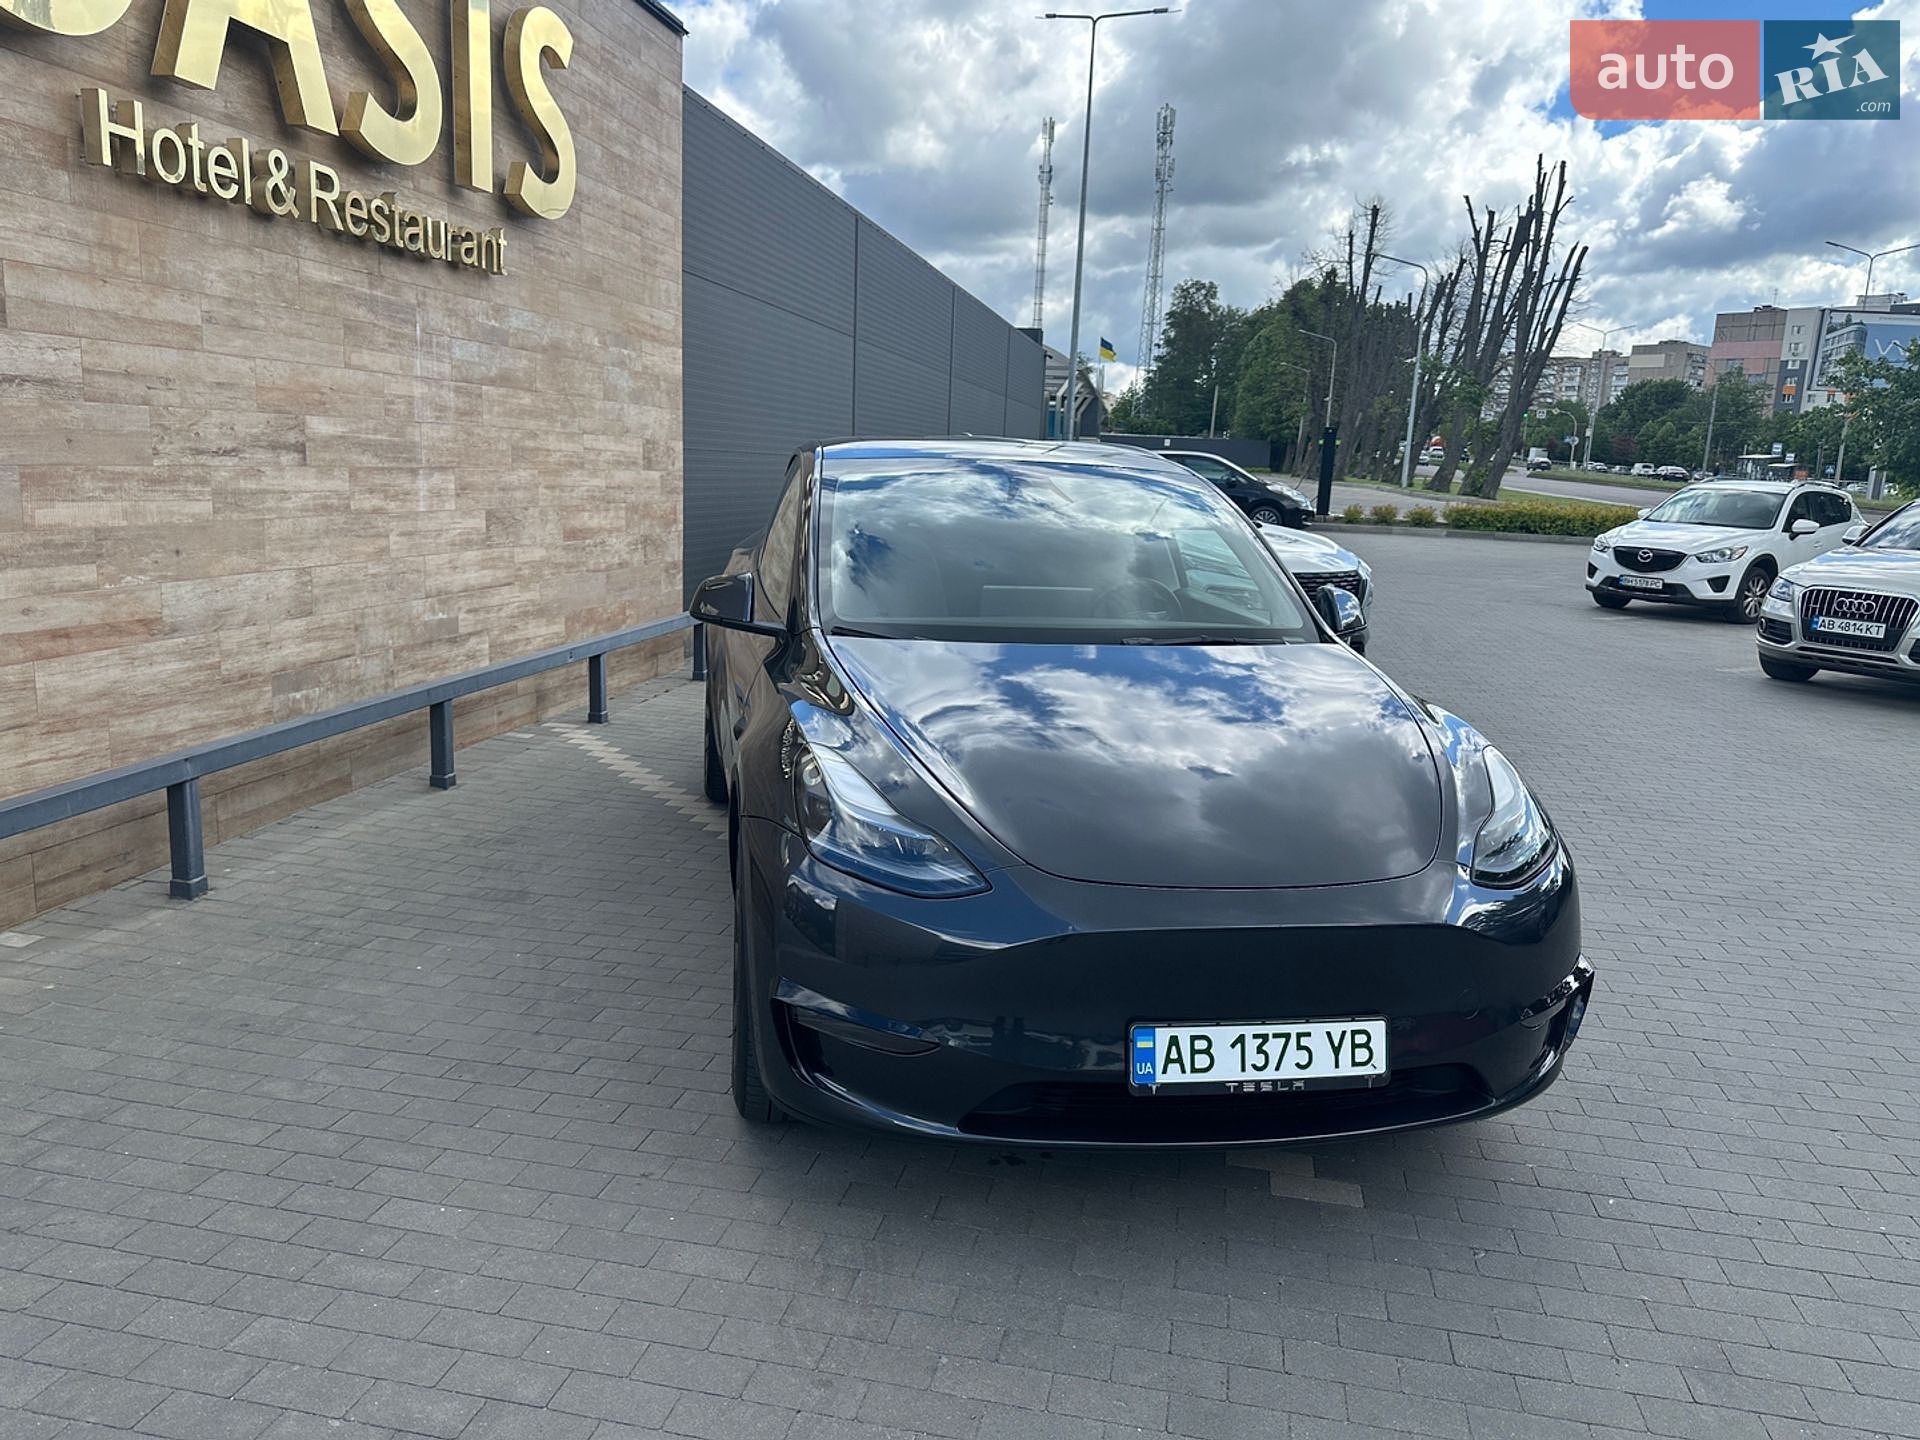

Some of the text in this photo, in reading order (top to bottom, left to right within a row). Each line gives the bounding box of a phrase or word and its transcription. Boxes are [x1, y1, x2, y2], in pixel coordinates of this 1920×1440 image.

[0, 0, 577, 220] ASIS
[86, 88, 508, 276] Hotel & Restaurant
[1819, 618, 1883, 635] AB 4814 KT
[1161, 1029, 1374, 1075] AB 1375 YB
[1136, 1062, 1153, 1075] UA
[1225, 1080, 1305, 1093] TESLA
